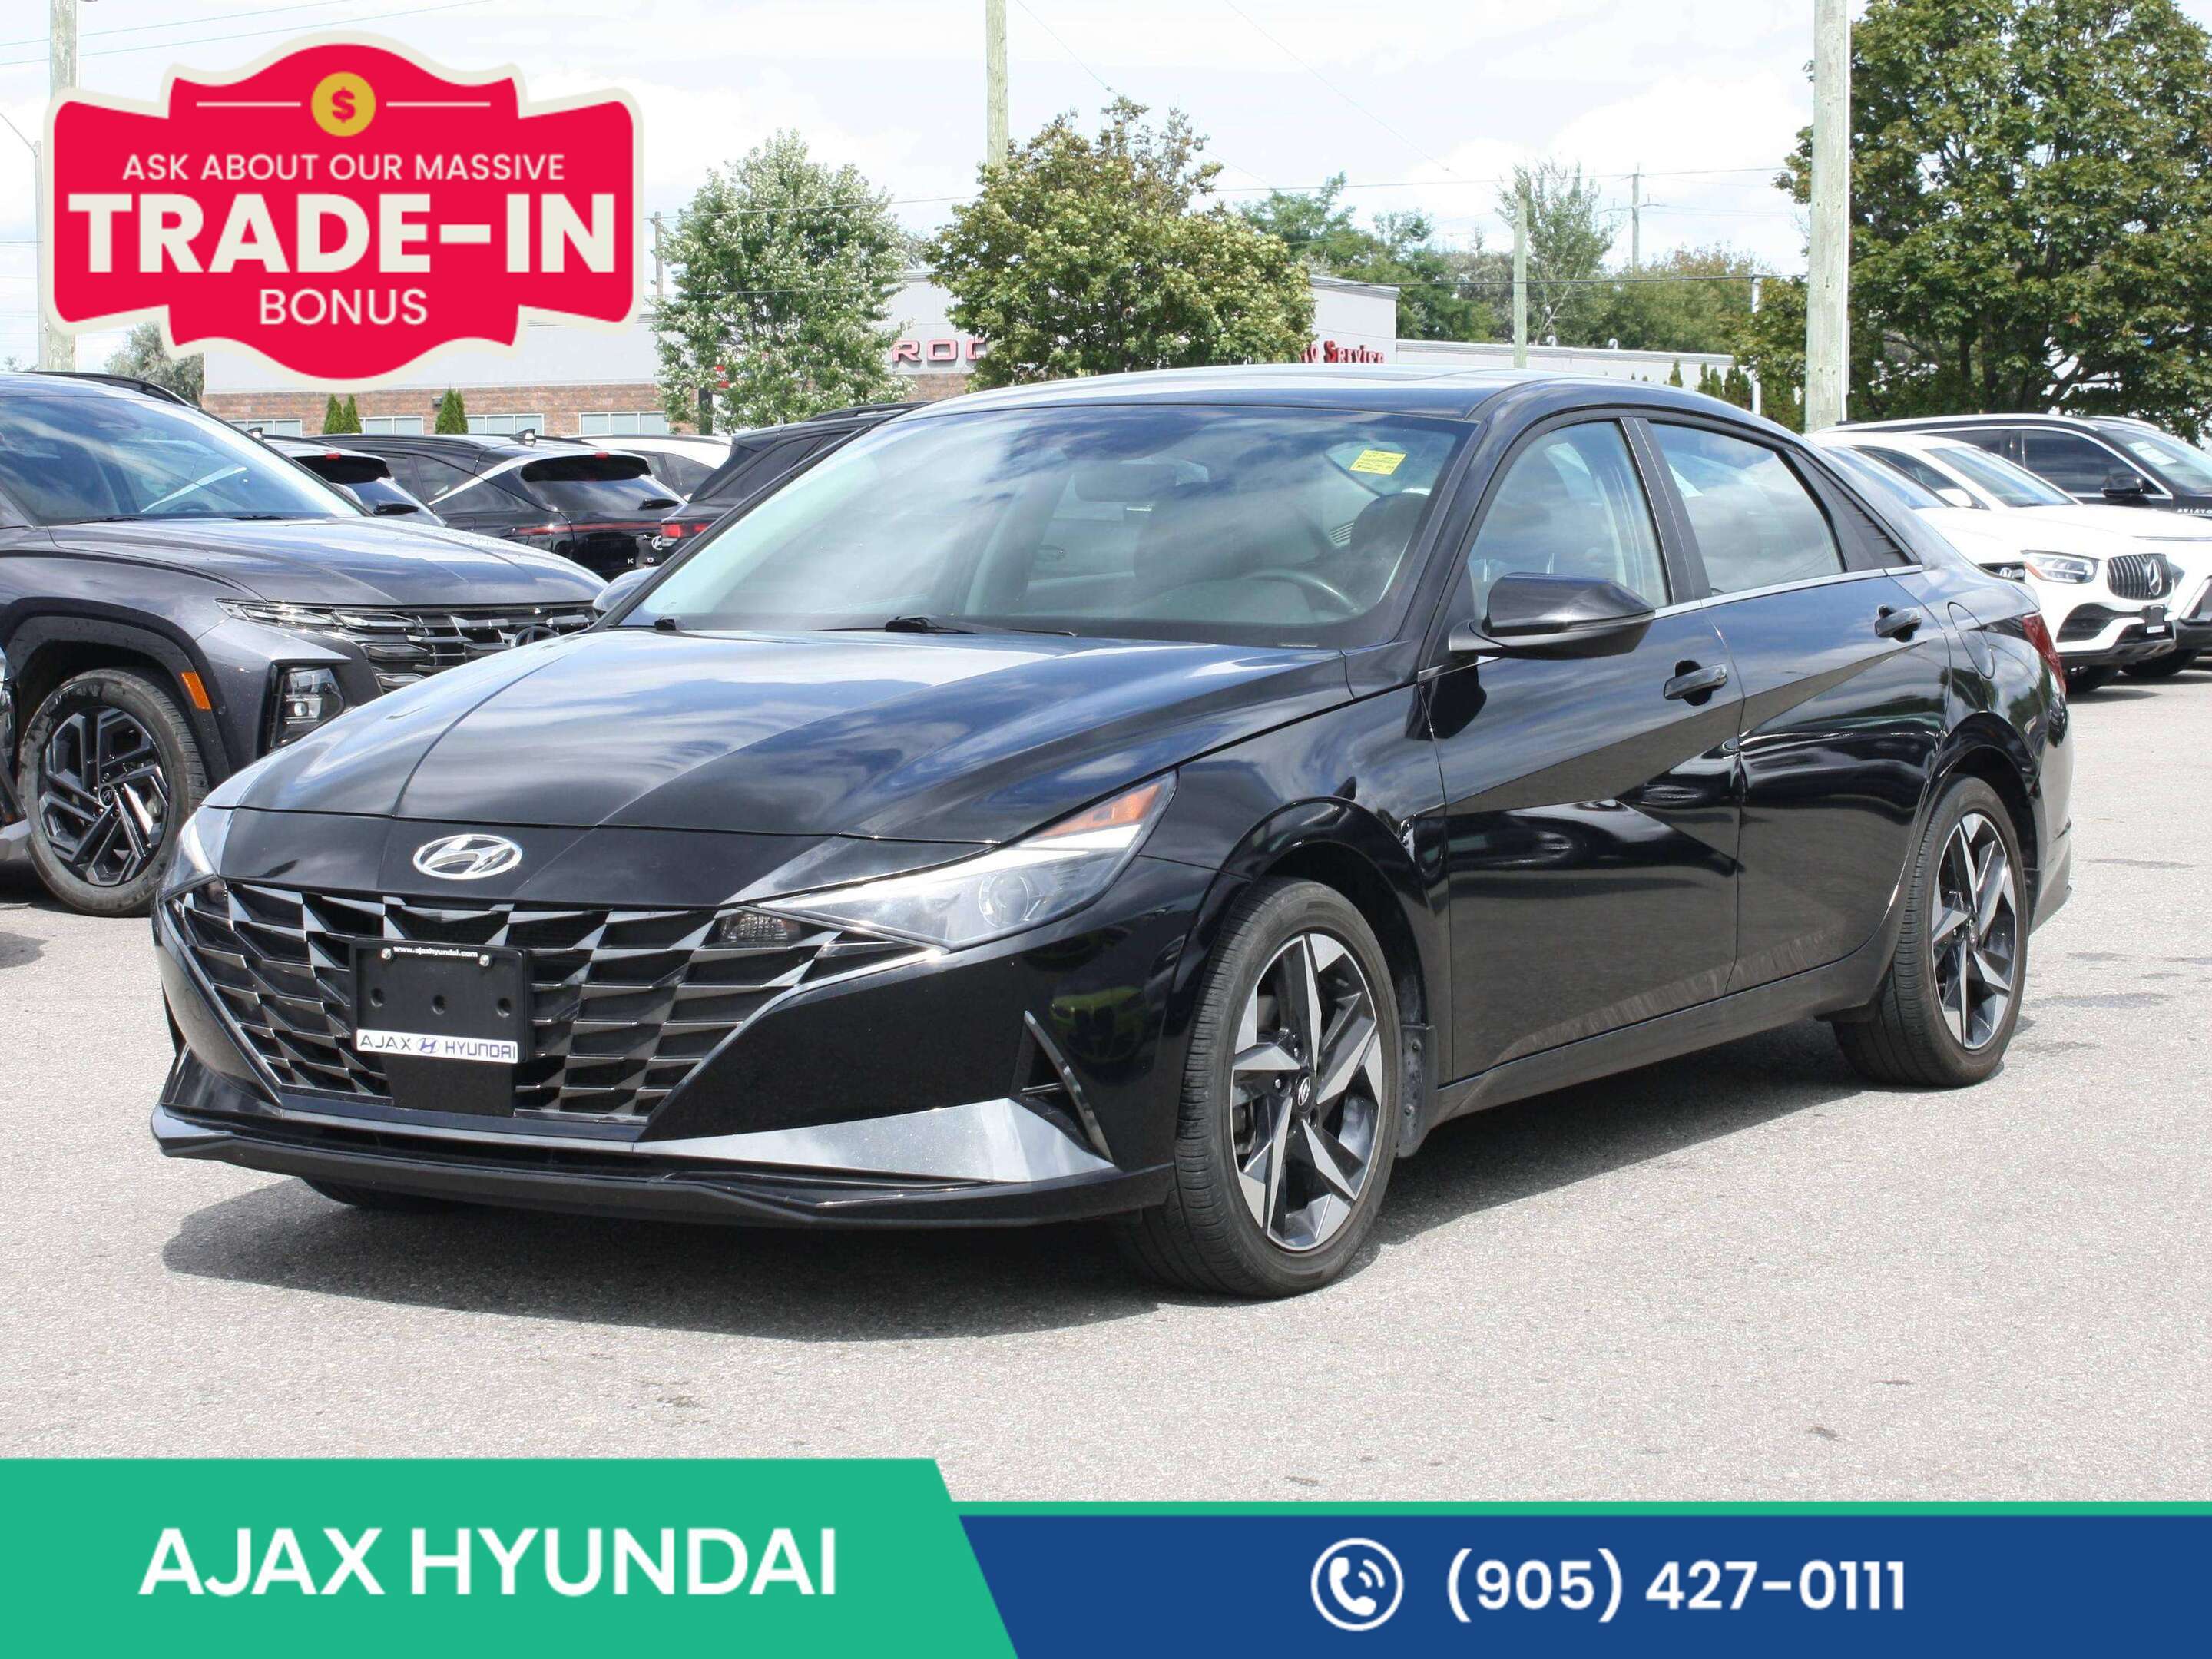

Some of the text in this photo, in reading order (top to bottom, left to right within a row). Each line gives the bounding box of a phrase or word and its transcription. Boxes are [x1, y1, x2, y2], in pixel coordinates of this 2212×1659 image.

[392, 945, 478, 957] www.ajaxhyundai.com
[359, 1035, 516, 1059] AJAX HYUNDAI
